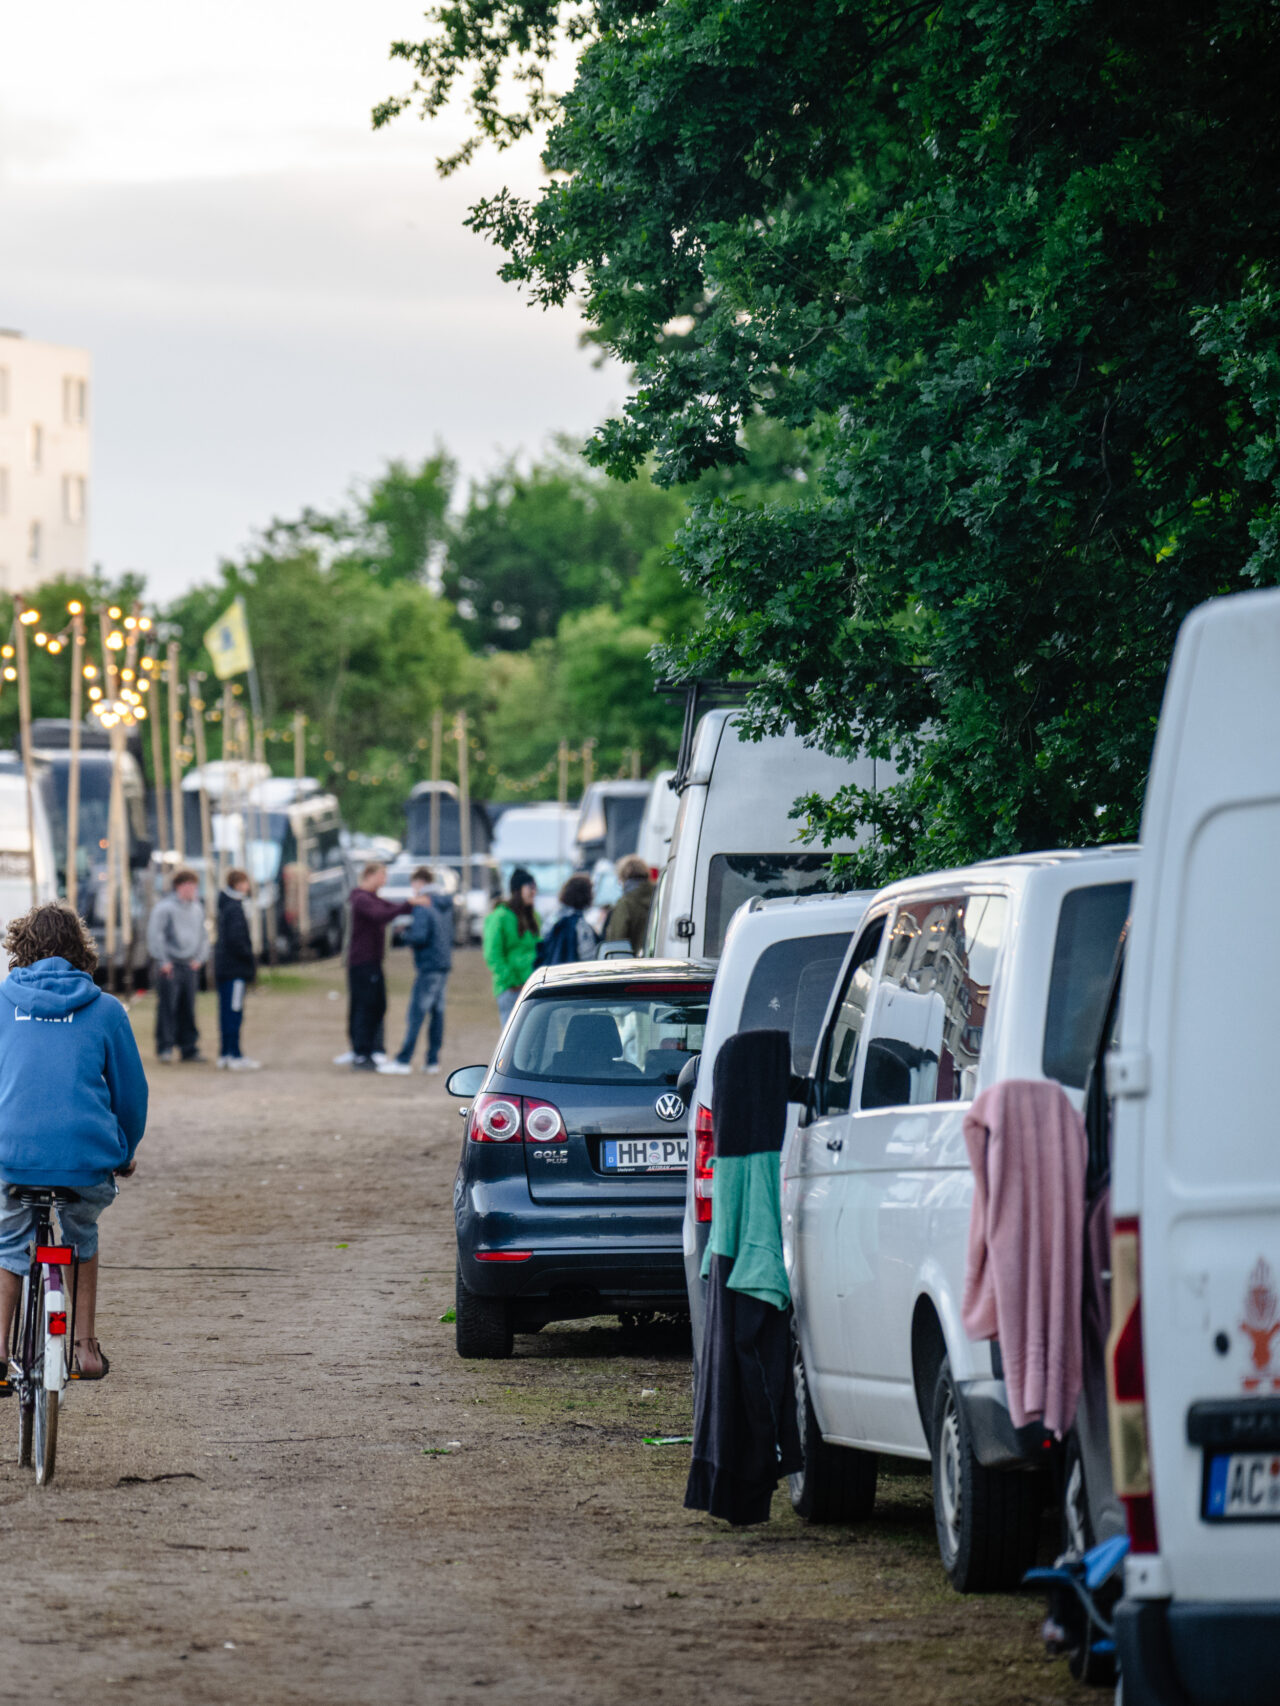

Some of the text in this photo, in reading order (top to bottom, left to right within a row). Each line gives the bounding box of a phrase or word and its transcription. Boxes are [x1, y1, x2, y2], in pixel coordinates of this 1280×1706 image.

[533, 1150, 568, 1159] GOLF
[619, 1143, 647, 1164] HH
[1230, 1462, 1265, 1505] AC
